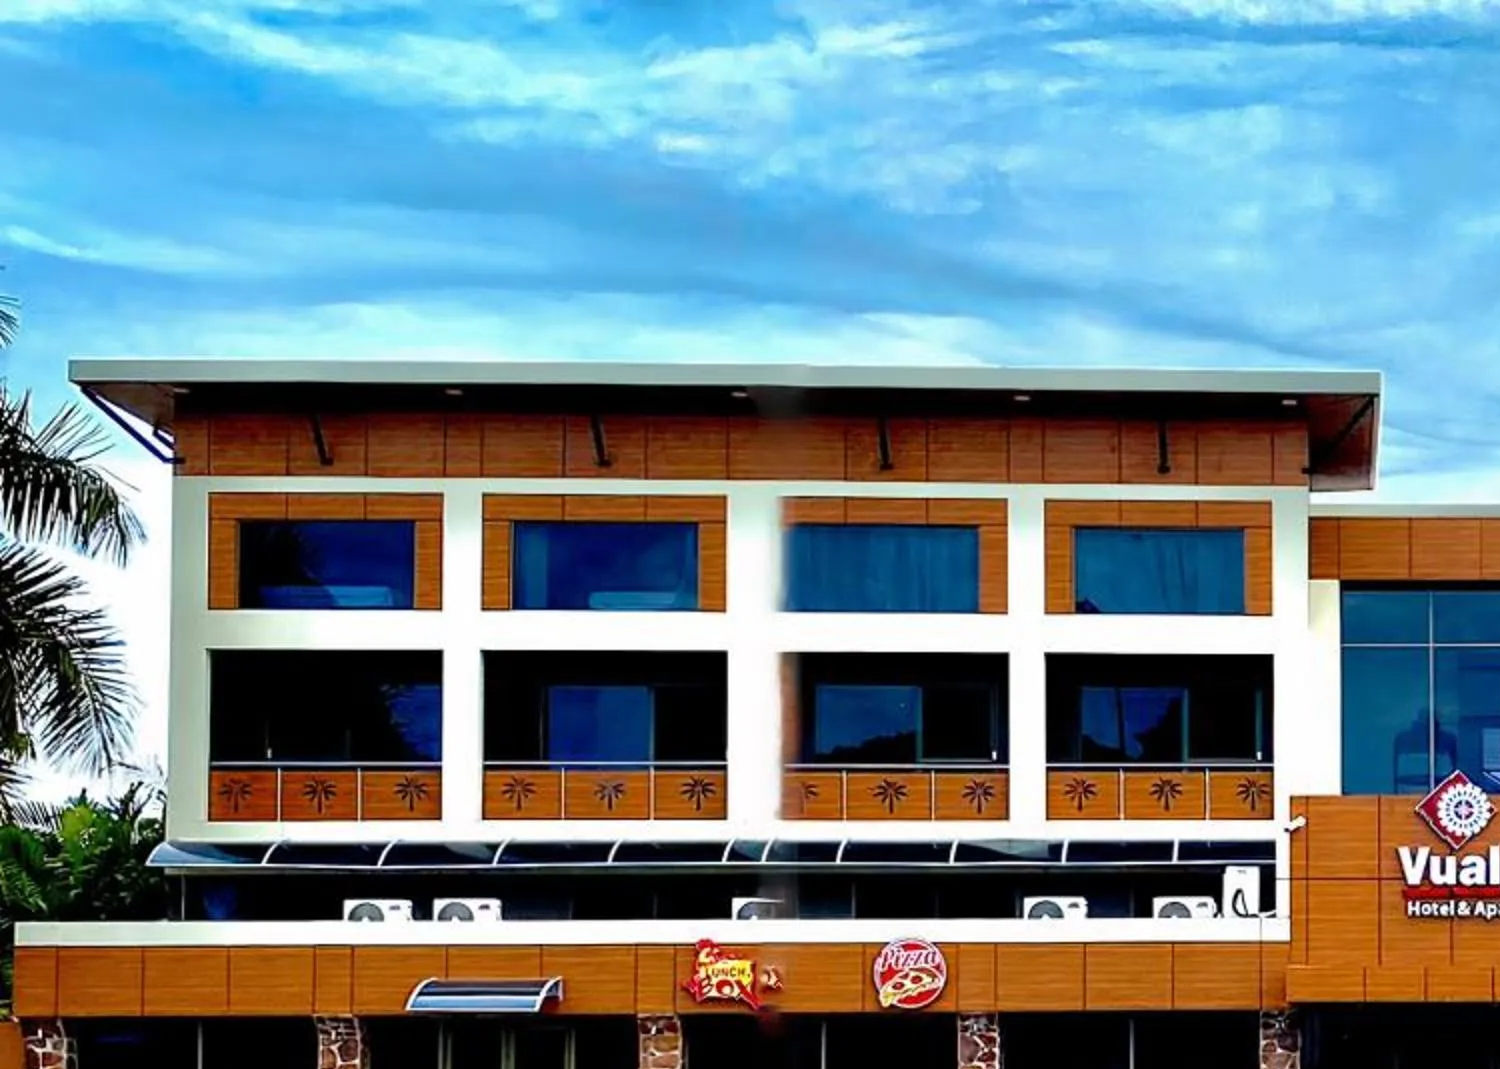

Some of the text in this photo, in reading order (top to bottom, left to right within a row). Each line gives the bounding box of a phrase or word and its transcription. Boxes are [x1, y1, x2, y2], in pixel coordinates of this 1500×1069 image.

[1407, 901, 1455, 918] Hotel
[1457, 902, 1470, 917] &
[881, 948, 938, 970] Pizza
